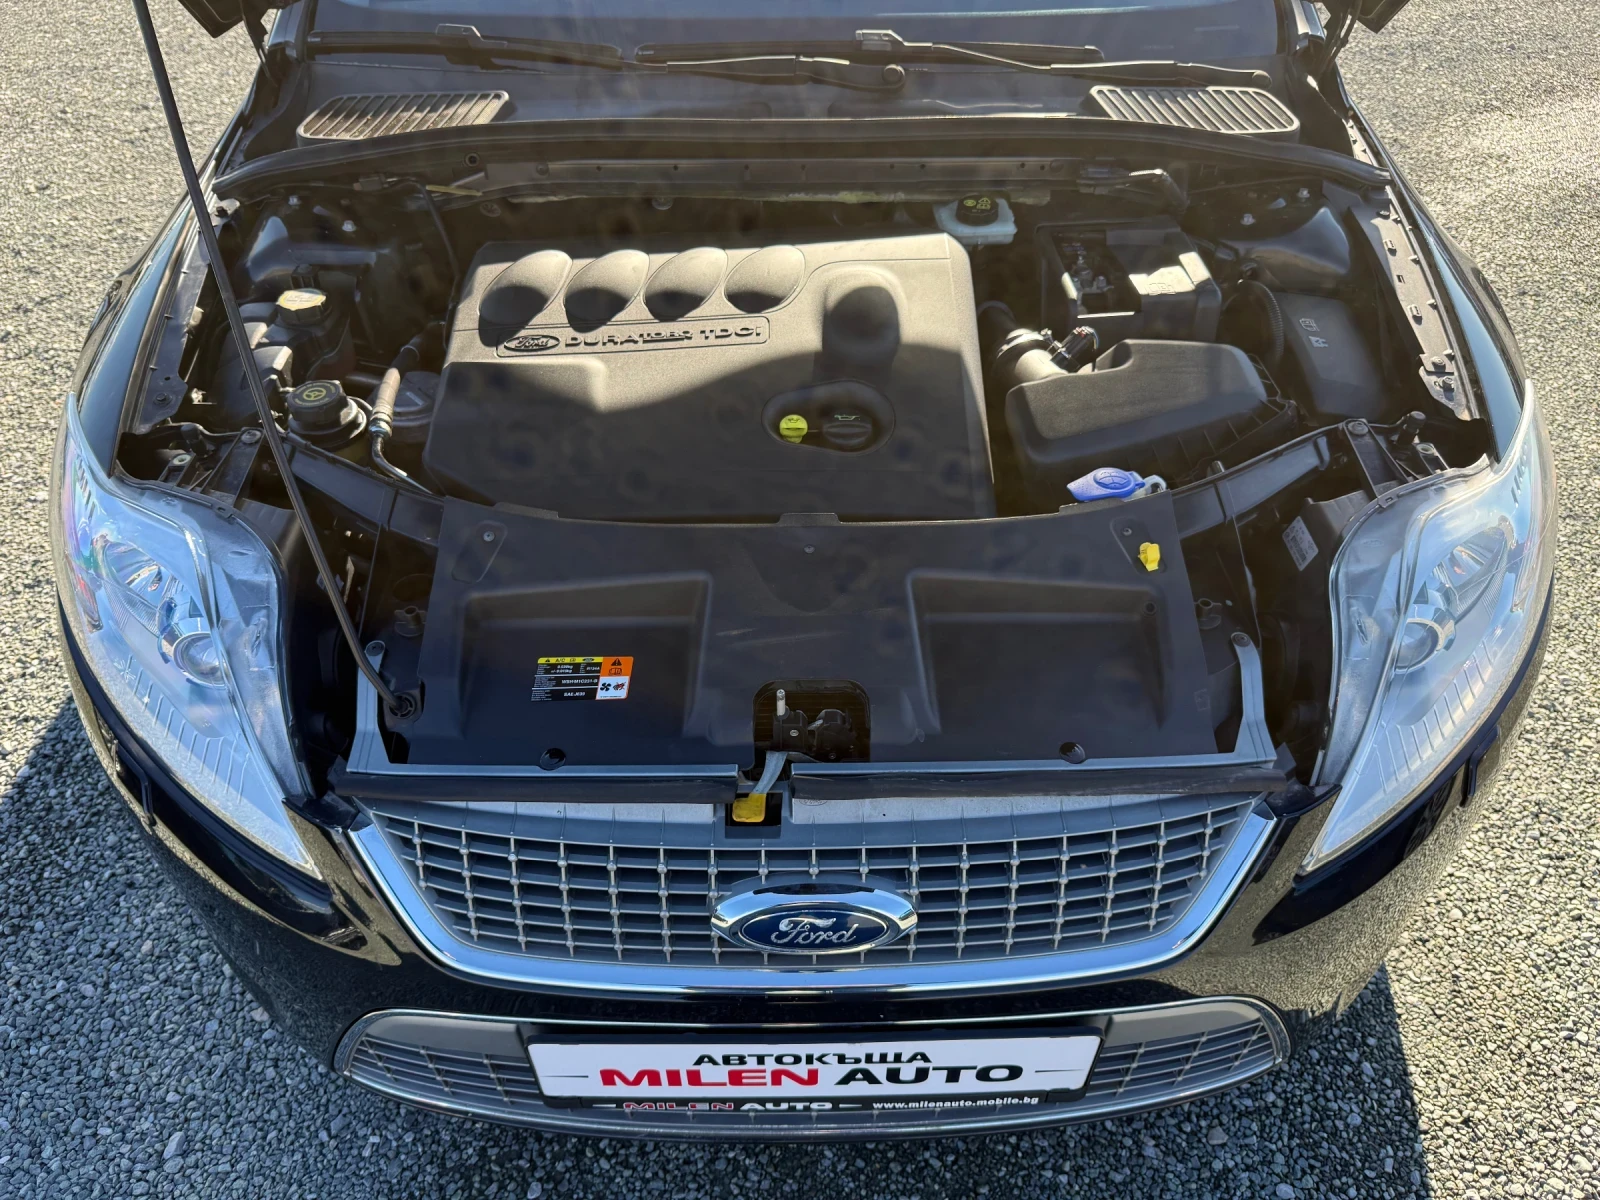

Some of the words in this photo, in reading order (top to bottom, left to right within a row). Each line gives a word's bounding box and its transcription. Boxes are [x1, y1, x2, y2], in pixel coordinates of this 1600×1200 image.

[515, 335, 549, 348] Ford
[771, 917, 859, 944] Ford
[600, 1067, 819, 1087] MILEN
[834, 1064, 1023, 1086] AUTO
[622, 1102, 734, 1111] MILEN
[740, 1102, 833, 1111] AUTO
[872, 1096, 1039, 1110] www.milenauto.mobile.bg
